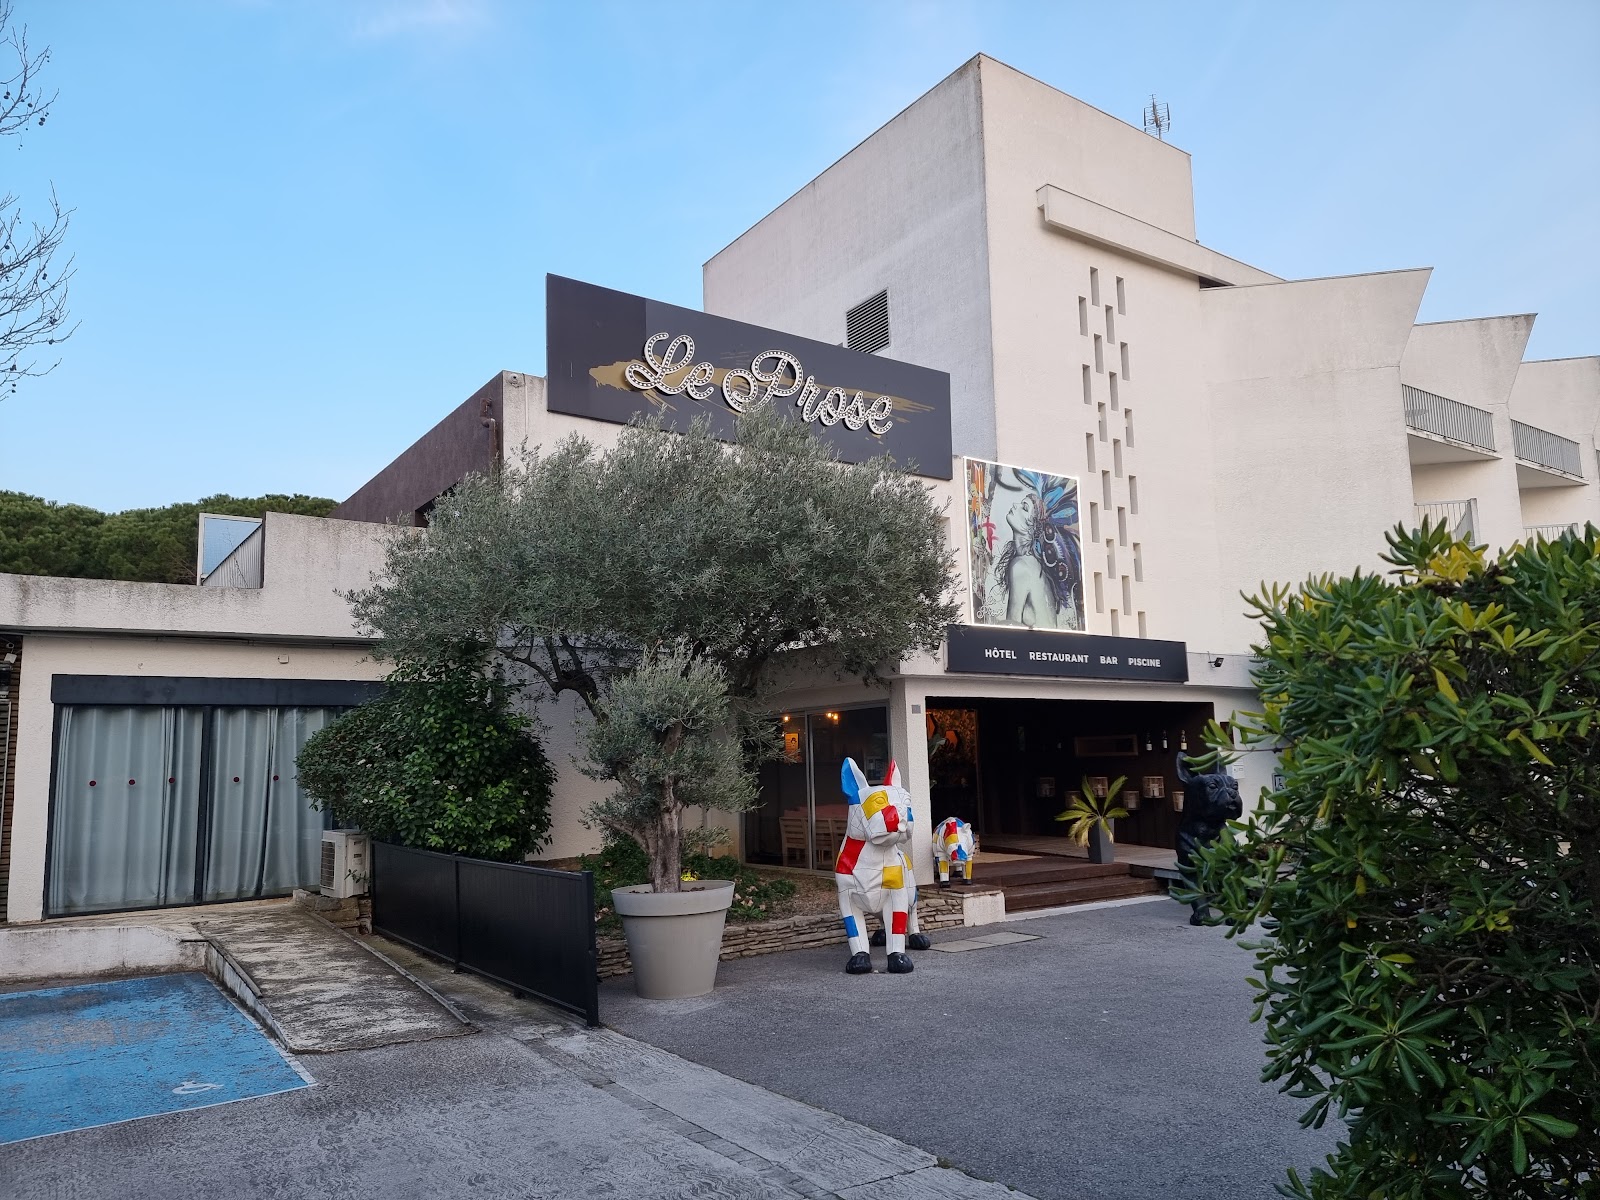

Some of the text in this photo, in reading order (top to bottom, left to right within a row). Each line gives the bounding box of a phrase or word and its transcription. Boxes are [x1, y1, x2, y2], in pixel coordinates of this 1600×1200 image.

[625, 332, 894, 435] Le Prose
[984, 647, 1161, 668] HÔTEL RESTAURANT BAR PISCINE
